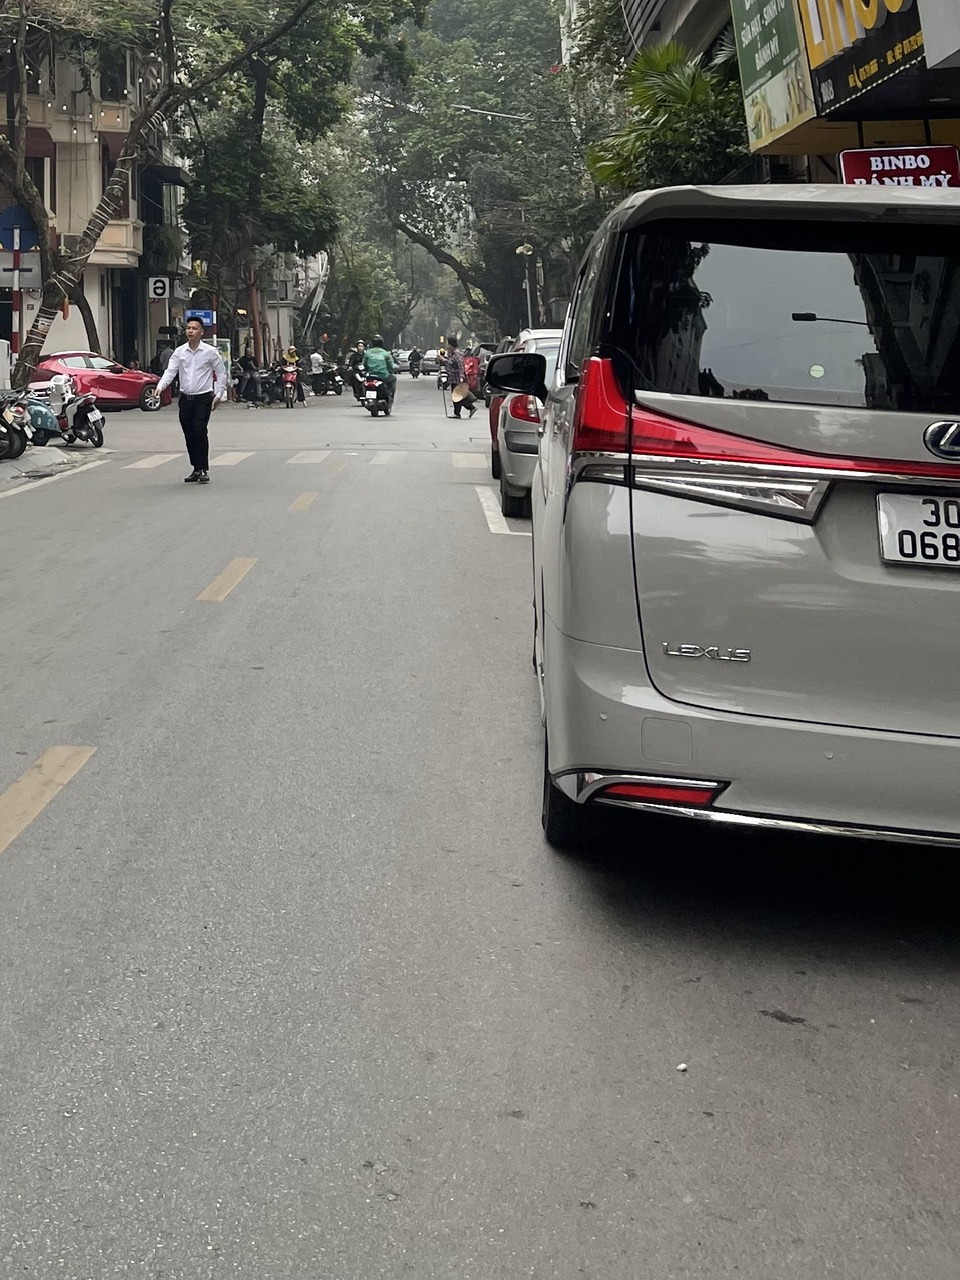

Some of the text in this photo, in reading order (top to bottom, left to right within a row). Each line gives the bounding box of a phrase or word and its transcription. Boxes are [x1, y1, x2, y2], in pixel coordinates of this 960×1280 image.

[869, 154, 931, 171] BINBO
[898, 530, 960, 562] 068
[662, 642, 751, 662] LEXUS
